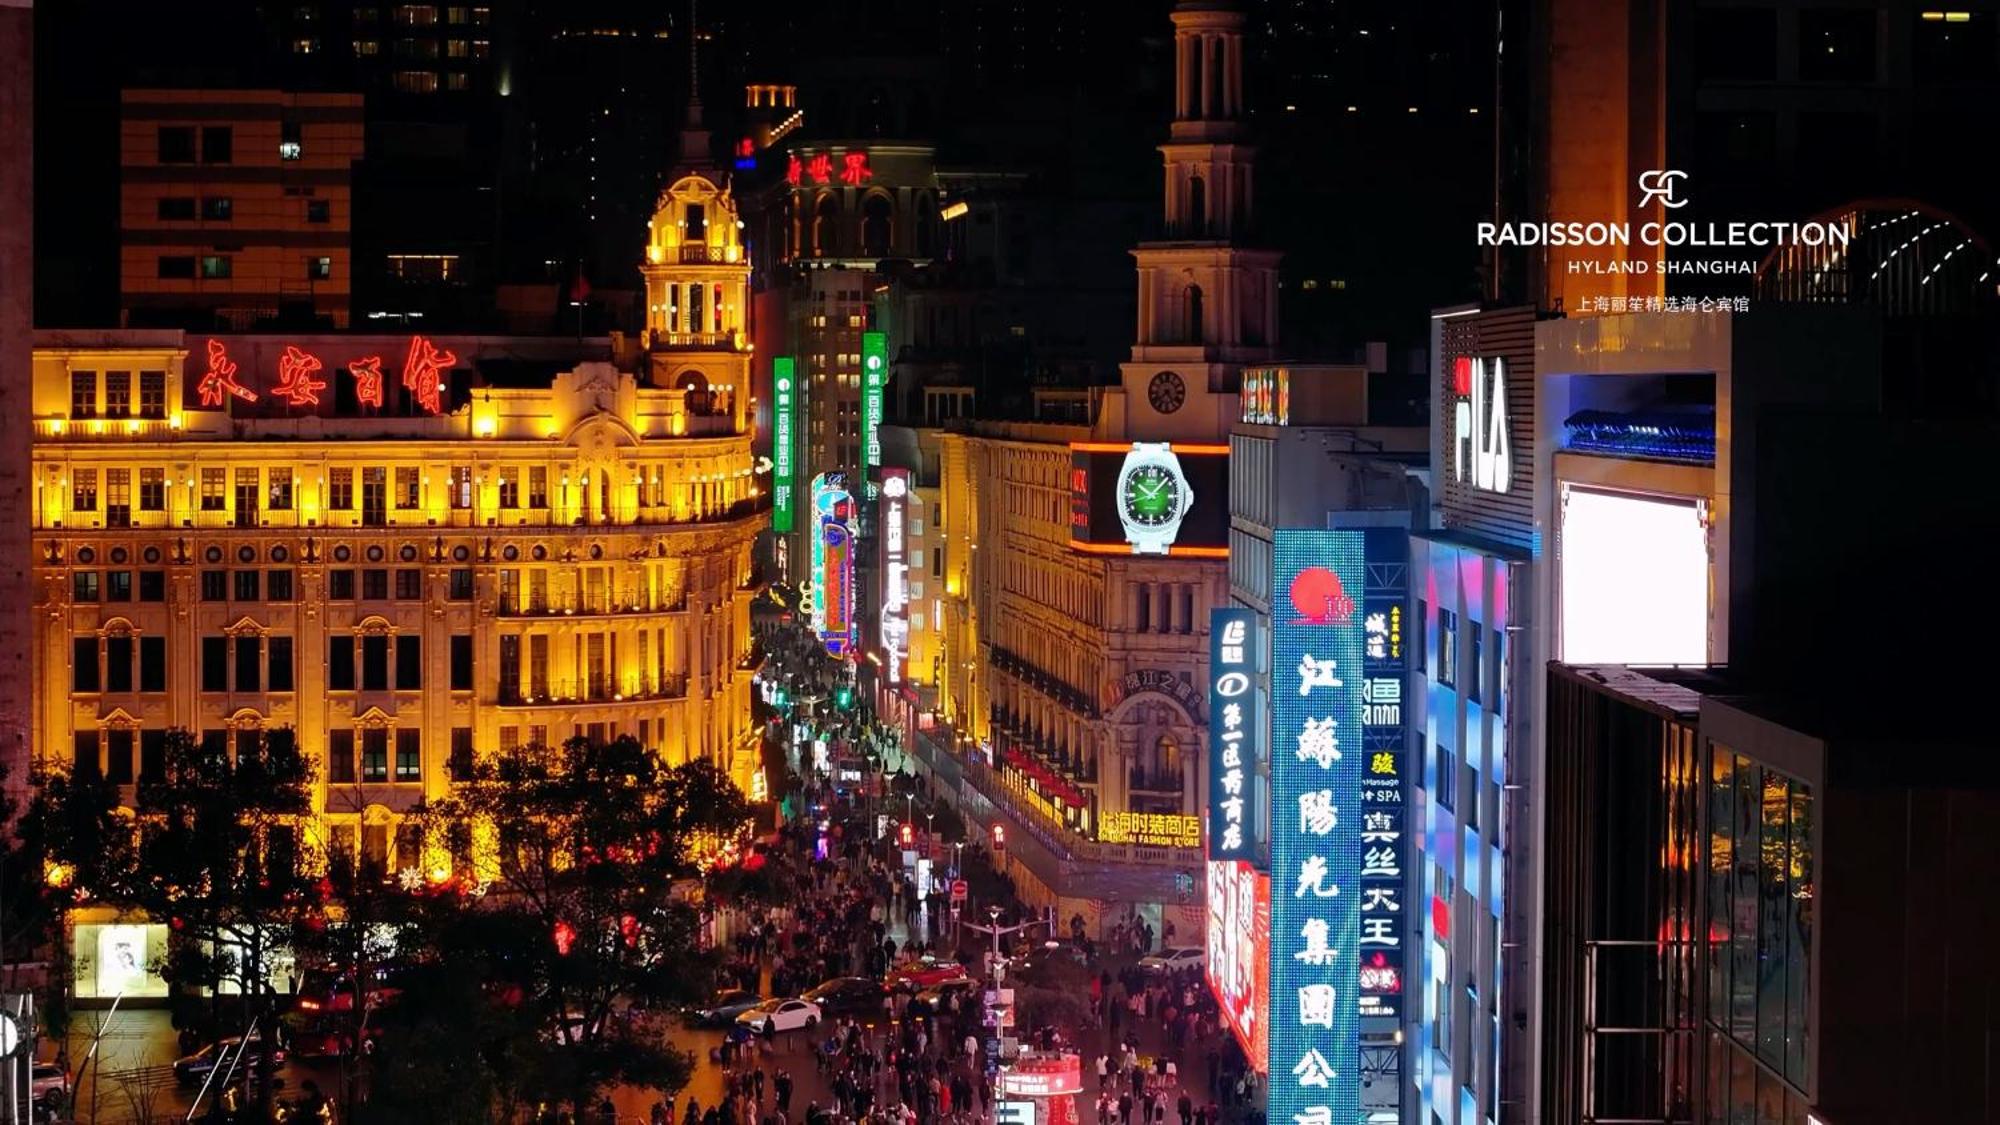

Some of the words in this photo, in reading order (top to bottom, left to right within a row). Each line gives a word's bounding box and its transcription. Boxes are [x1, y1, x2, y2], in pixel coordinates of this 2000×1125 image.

[1454, 355, 1510, 494] FILA
[1376, 789, 1402, 803] SPA
[1100, 811, 1200, 836] 上海时装商店
